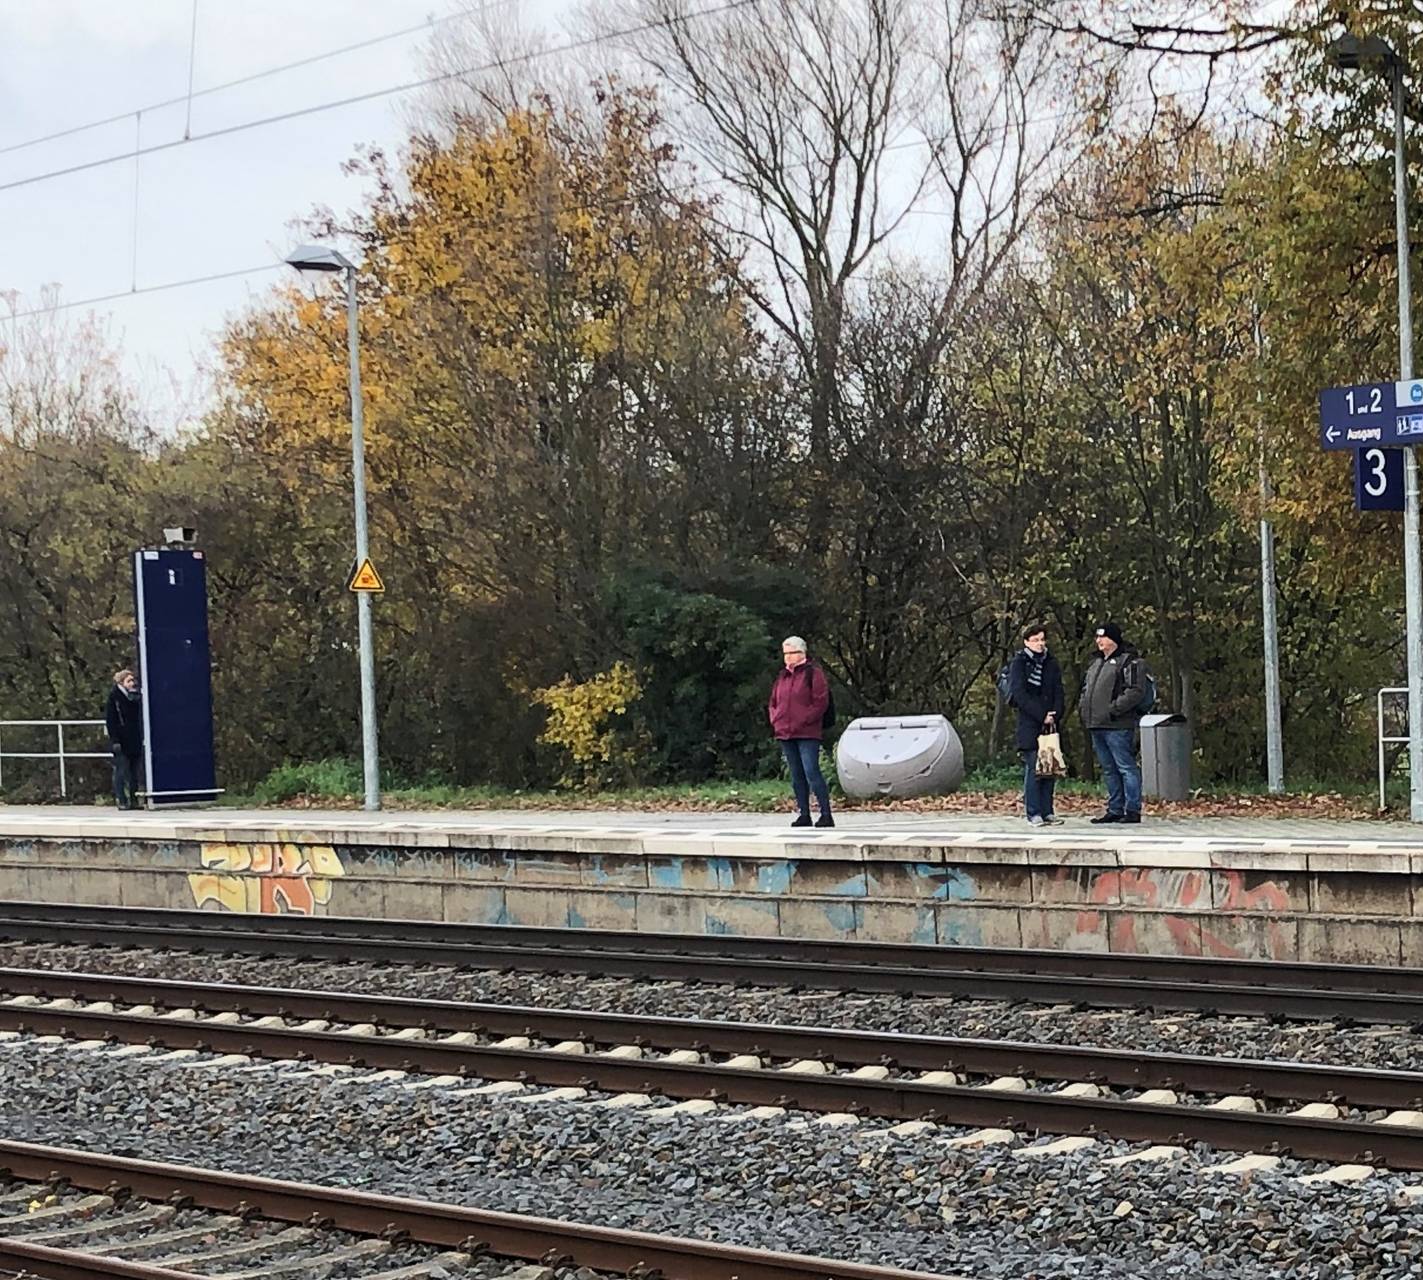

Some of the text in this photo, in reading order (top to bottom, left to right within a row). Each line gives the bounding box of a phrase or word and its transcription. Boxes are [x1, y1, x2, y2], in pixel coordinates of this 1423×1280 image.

[1345, 391, 1354, 415] 1
[1370, 388, 1382, 413] 2
[1347, 428, 1381, 441] Ausgang
[1364, 449, 1387, 496] 3
